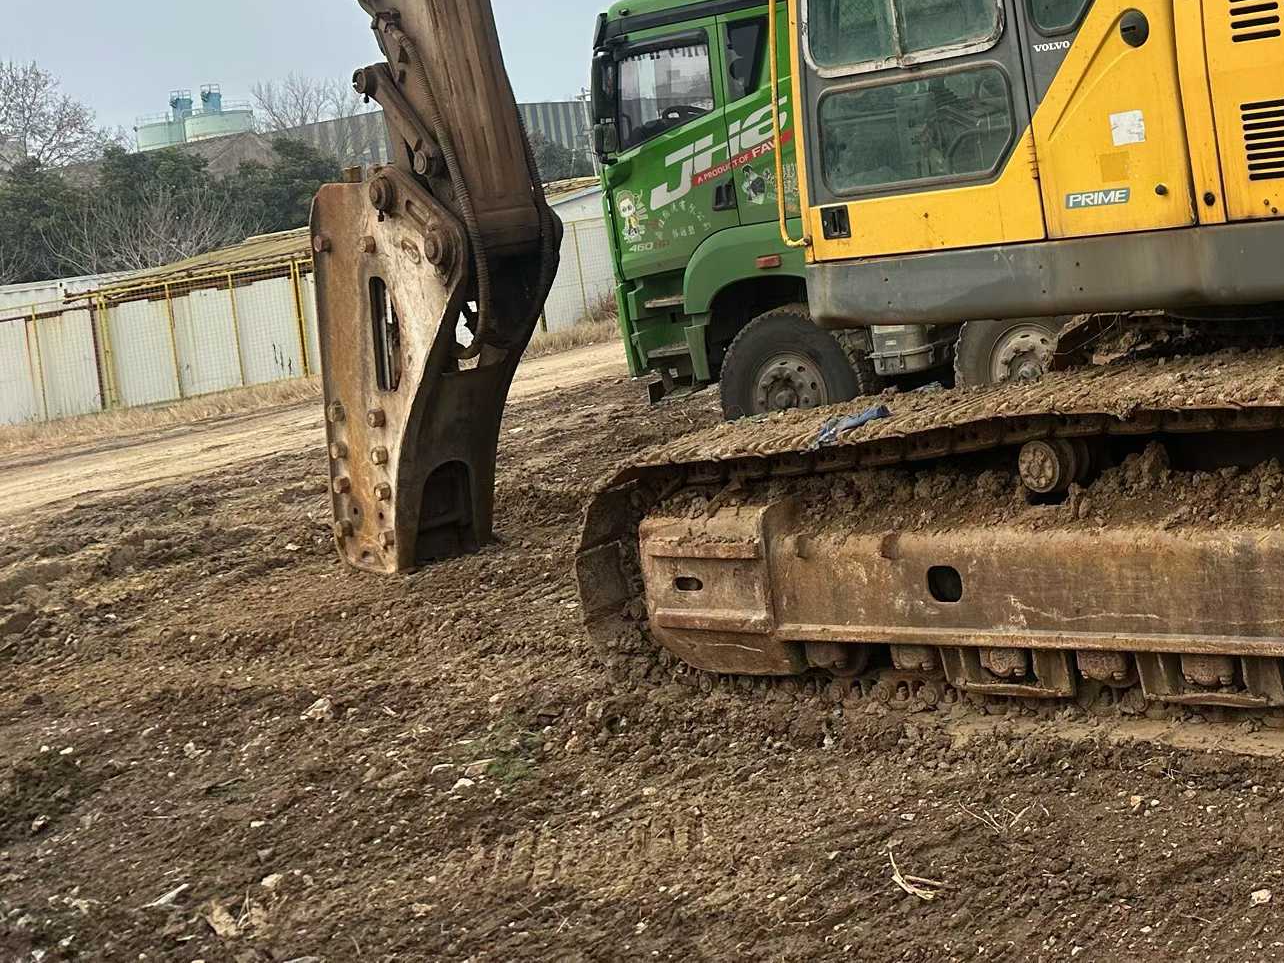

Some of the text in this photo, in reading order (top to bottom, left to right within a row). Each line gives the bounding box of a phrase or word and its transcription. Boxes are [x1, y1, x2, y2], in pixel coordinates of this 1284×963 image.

[1033, 40, 1070, 52] VOLVO
[703, 159, 739, 182] PRODUCT
[738, 153, 750, 165] OF
[1067, 188, 1128, 208] PRIME
